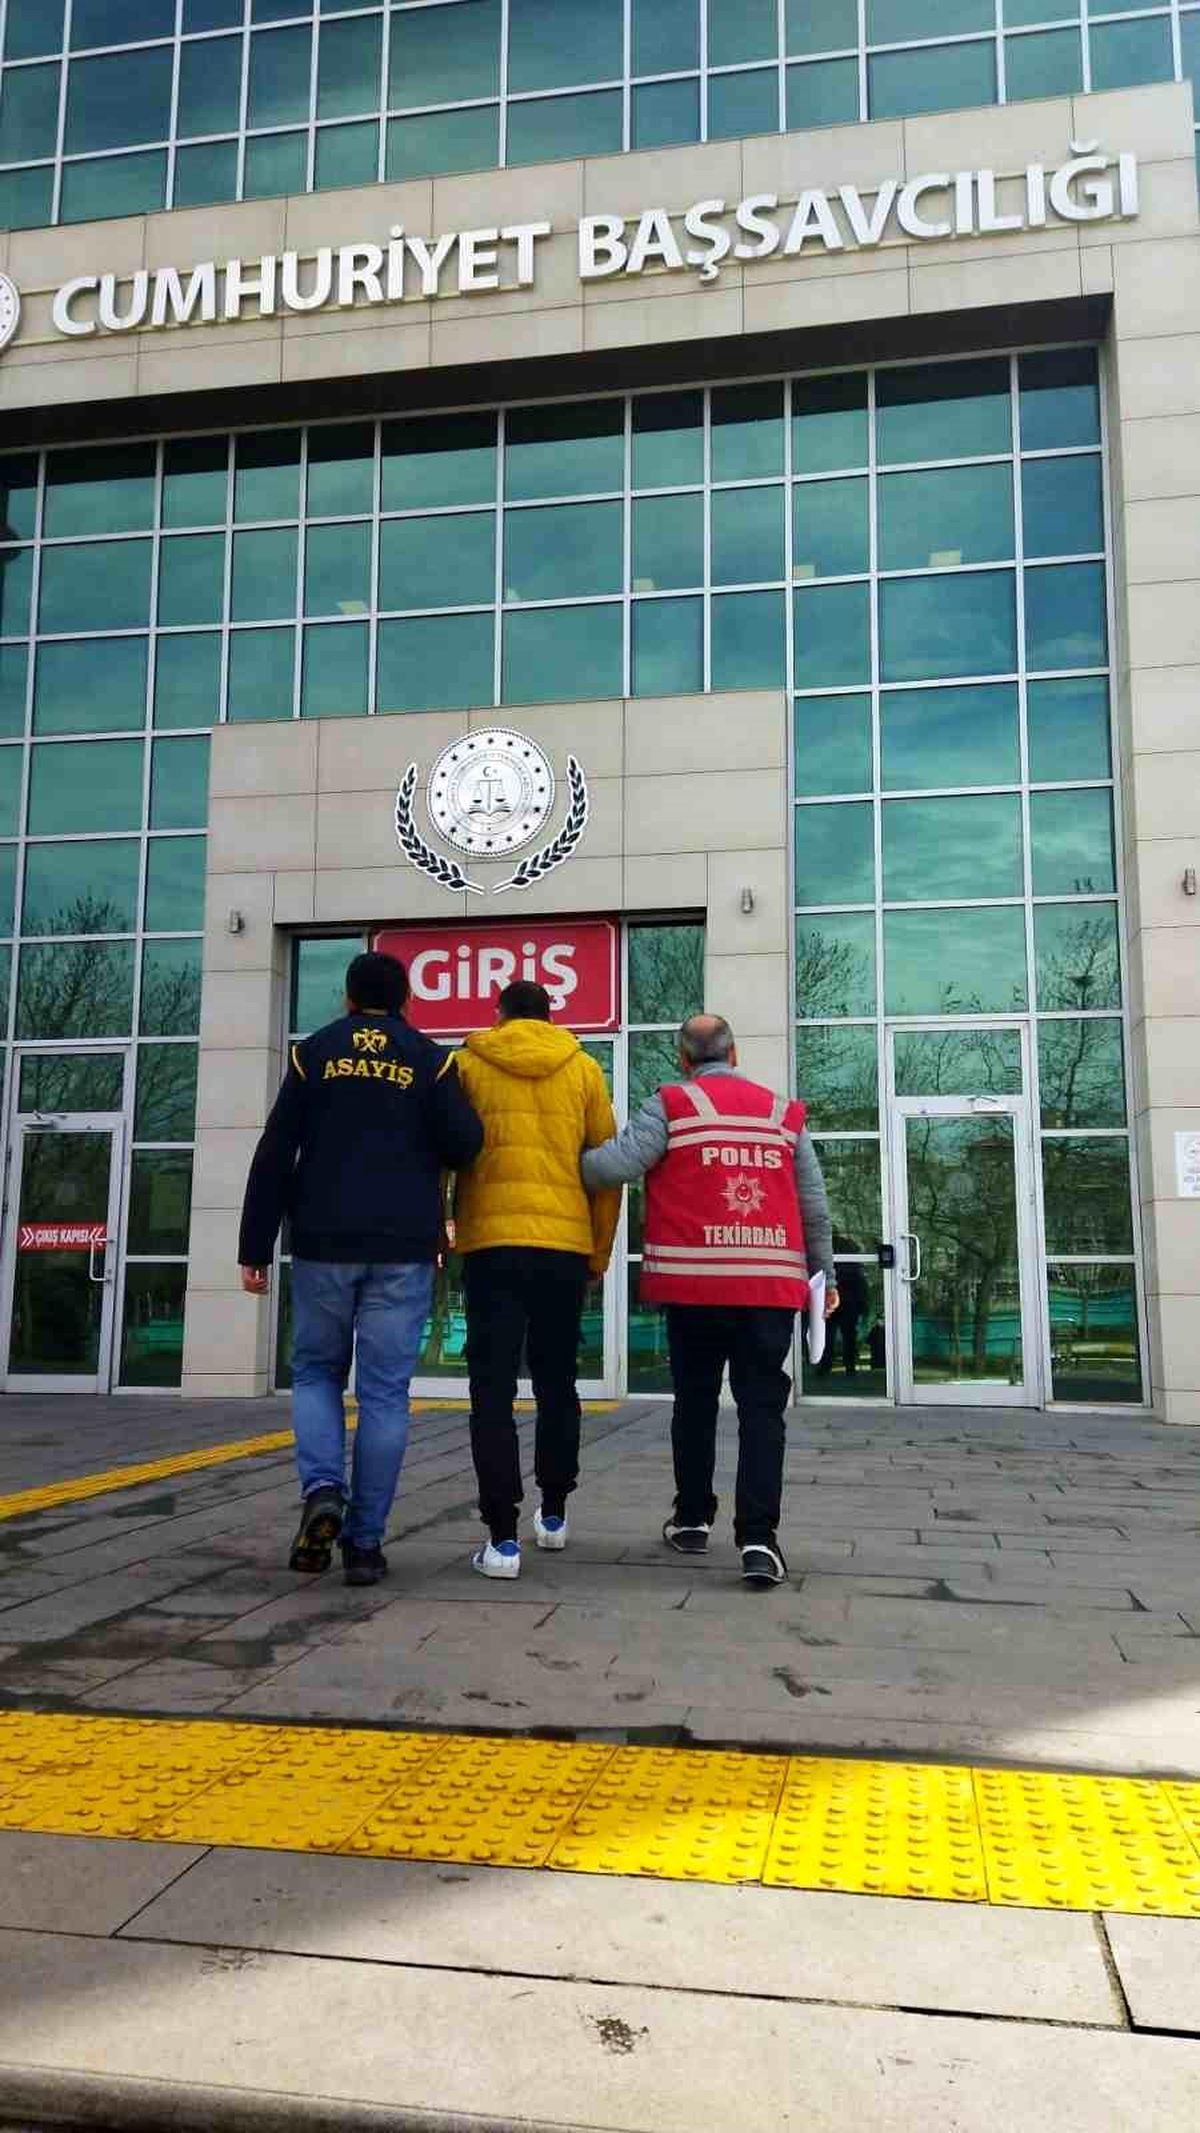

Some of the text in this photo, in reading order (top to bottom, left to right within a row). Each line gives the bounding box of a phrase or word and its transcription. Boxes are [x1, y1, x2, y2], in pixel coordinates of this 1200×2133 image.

[52, 139, 1139, 337] CUMHURİYET BAŞSAVCILIĞI
[409, 942, 578, 1010] GİRİŞ
[322, 1058, 414, 1090] ASAYİŞ
[702, 1145, 783, 1169] POLİS
[703, 1222, 787, 1246] TEKİRDAĞ
